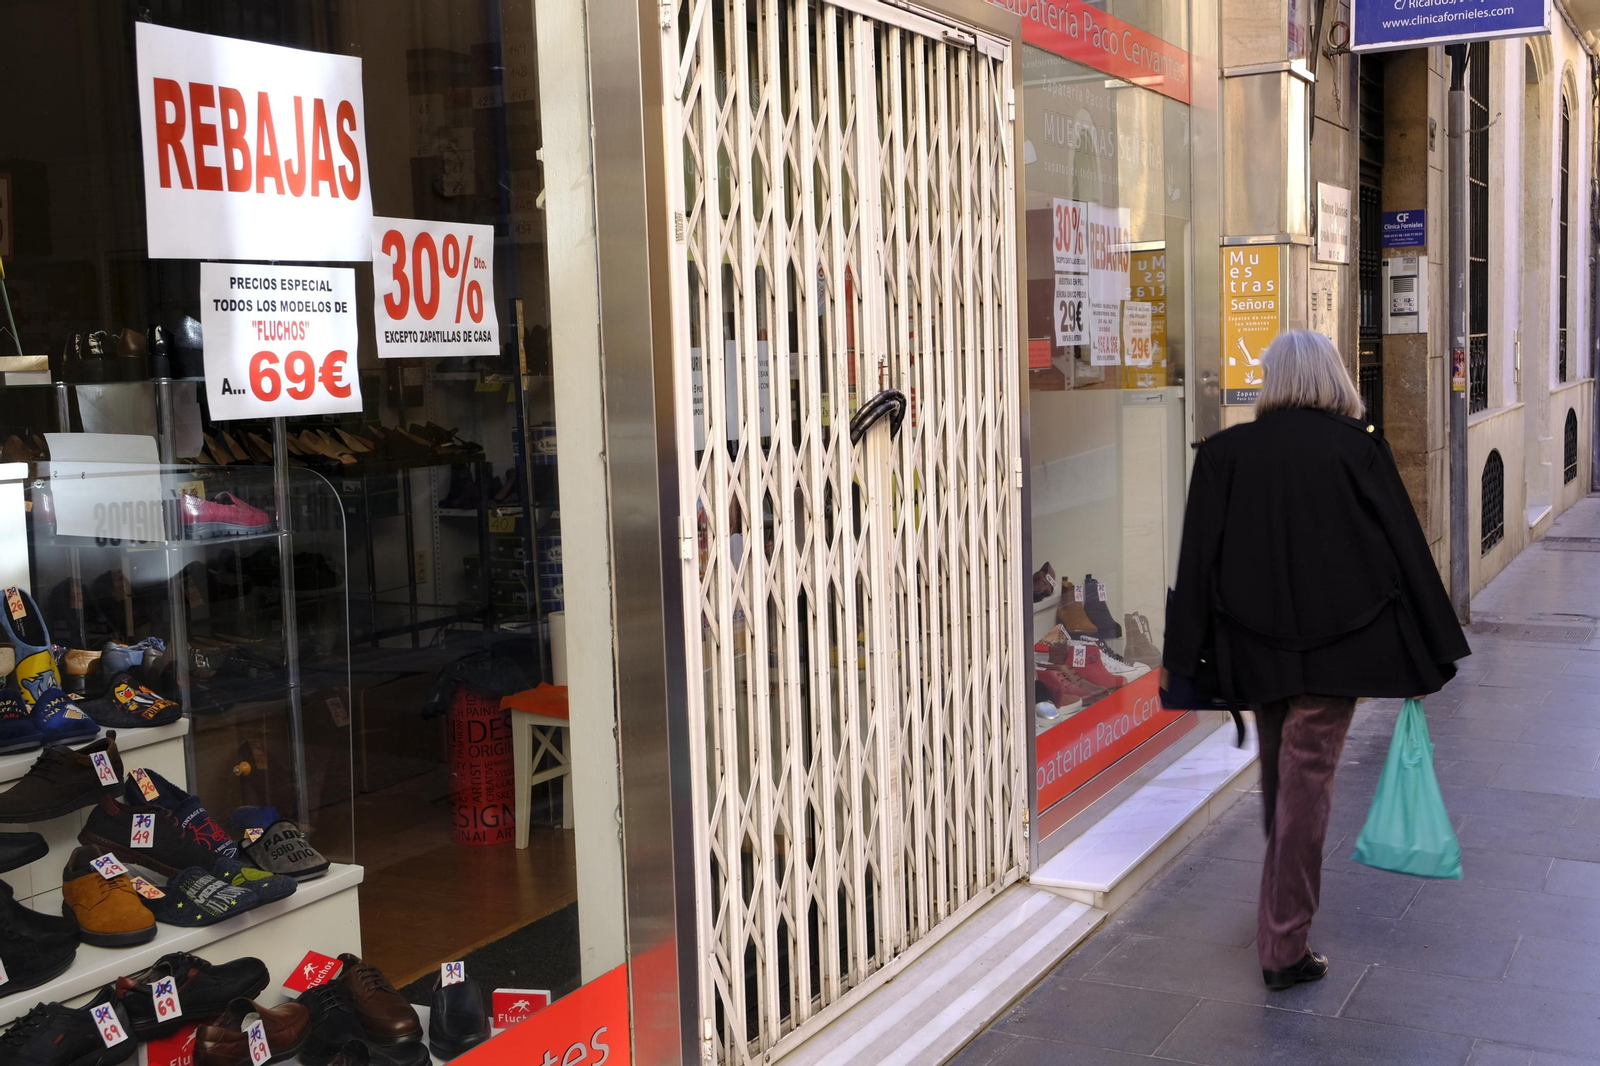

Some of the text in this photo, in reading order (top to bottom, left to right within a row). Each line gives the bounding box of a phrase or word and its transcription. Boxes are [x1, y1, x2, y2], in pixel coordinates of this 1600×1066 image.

[1382, 5, 1514, 29] www.clinicafornieles.com
[1083, 10, 1118, 55] Paco
[1122, 30, 1187, 84] Cervantes
[153, 77, 361, 201] REBAJAS
[1043, 109, 1115, 161] MUESTRAS
[1396, 213, 1409, 223] CF
[1401, 221, 1424, 230] Fornieles
[1055, 204, 1084, 255] 30%
[1090, 222, 1130, 274] REBAJAS
[474, 257, 487, 270] Dto.
[1230, 251, 1259, 267] Mu
[382, 229, 483, 324] 30%
[1230, 266, 1252, 279] es
[230, 277, 332, 292] PRECIOS ESPECIAL
[1230, 280, 1275, 293] tras
[213, 299, 348, 313] TODOS LOS MODELOS DE
[1230, 298, 1274, 311] Señora
[1060, 300, 1084, 332] 29€
[252, 320, 309, 341] "FLUCHOS"
[385, 331, 492, 343] EXCEPTO ZAPATILLAS DE CASA
[1131, 337, 1150, 359] 29€
[222, 350, 352, 402] A... 69€
[491, 517, 509, 531] 40
[11, 600, 23, 613] 26
[1074, 658, 1084, 666] 40
[1096, 713, 1130, 754] Paco
[99, 767, 115, 781] 49
[484, 761, 495, 802] CREATIVE
[142, 781, 155, 796] 26
[470, 762, 482, 803] ARTIST
[132, 830, 150, 844] 49
[270, 843, 294, 861] solo
[287, 848, 315, 863] uno
[104, 865, 123, 876] 49
[143, 889, 160, 900] 26
[445, 962, 462, 979] 99
[157, 998, 176, 1016] 69
[104, 1025, 122, 1042] 69
[252, 1043, 268, 1062] 69
